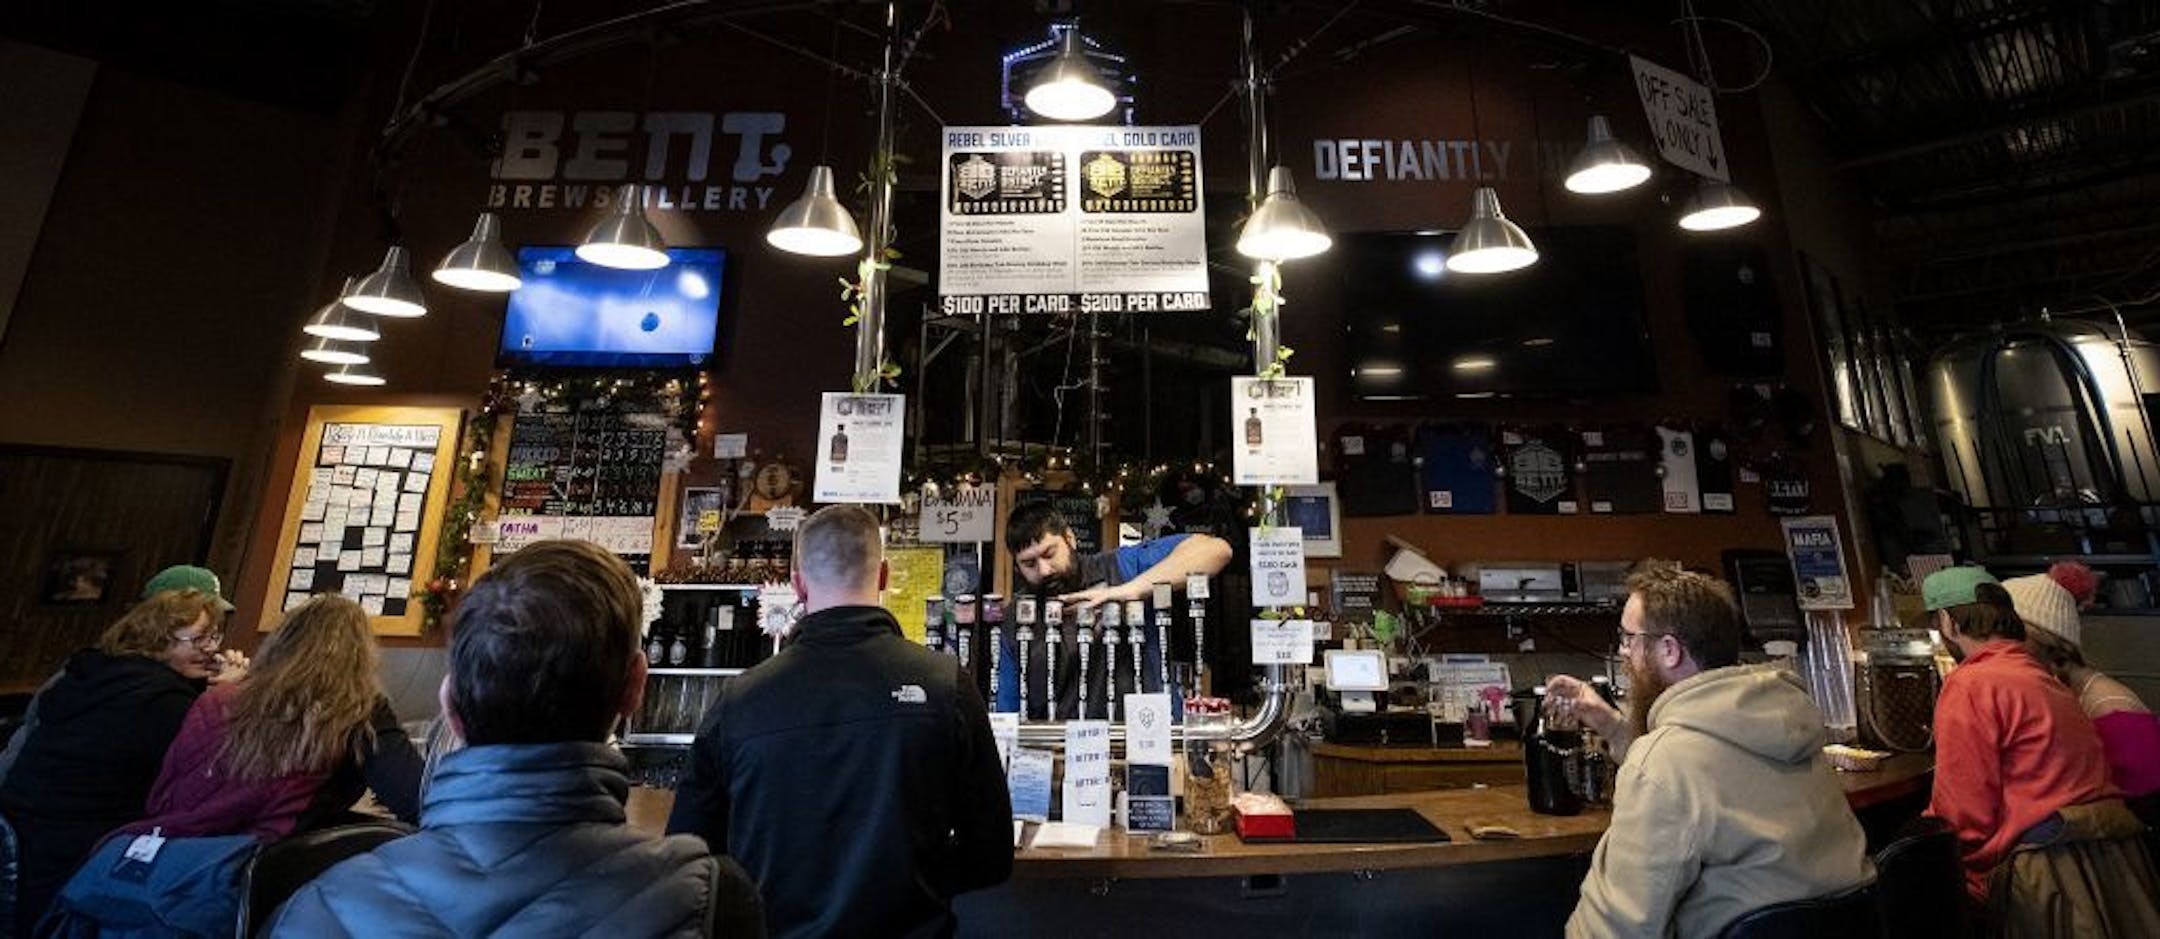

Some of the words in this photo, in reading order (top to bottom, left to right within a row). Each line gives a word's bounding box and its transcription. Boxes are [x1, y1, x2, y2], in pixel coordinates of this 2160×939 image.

[1639, 72, 1669, 110] OFF
[1674, 86, 1712, 129] SALE
[948, 133, 985, 147] REBEL
[990, 132, 1031, 147] SILVER
[1123, 132, 1156, 147] GOLD
[1161, 131, 1196, 147] CARD
[1665, 119, 1702, 160] ONLY
[1313, 137, 1512, 182] DEFIANTLY
[488, 183, 774, 211] BREWSILLERY
[944, 294, 984, 316] $100
[988, 294, 1021, 314] PER
[1025, 294, 1070, 313] CARD
[1081, 293, 1123, 313] $200
[1127, 293, 1158, 311] PER
[1162, 292, 1206, 310] CARD
[2024, 426, 2071, 448] FV1
[1792, 532, 1833, 546] MAFIA
